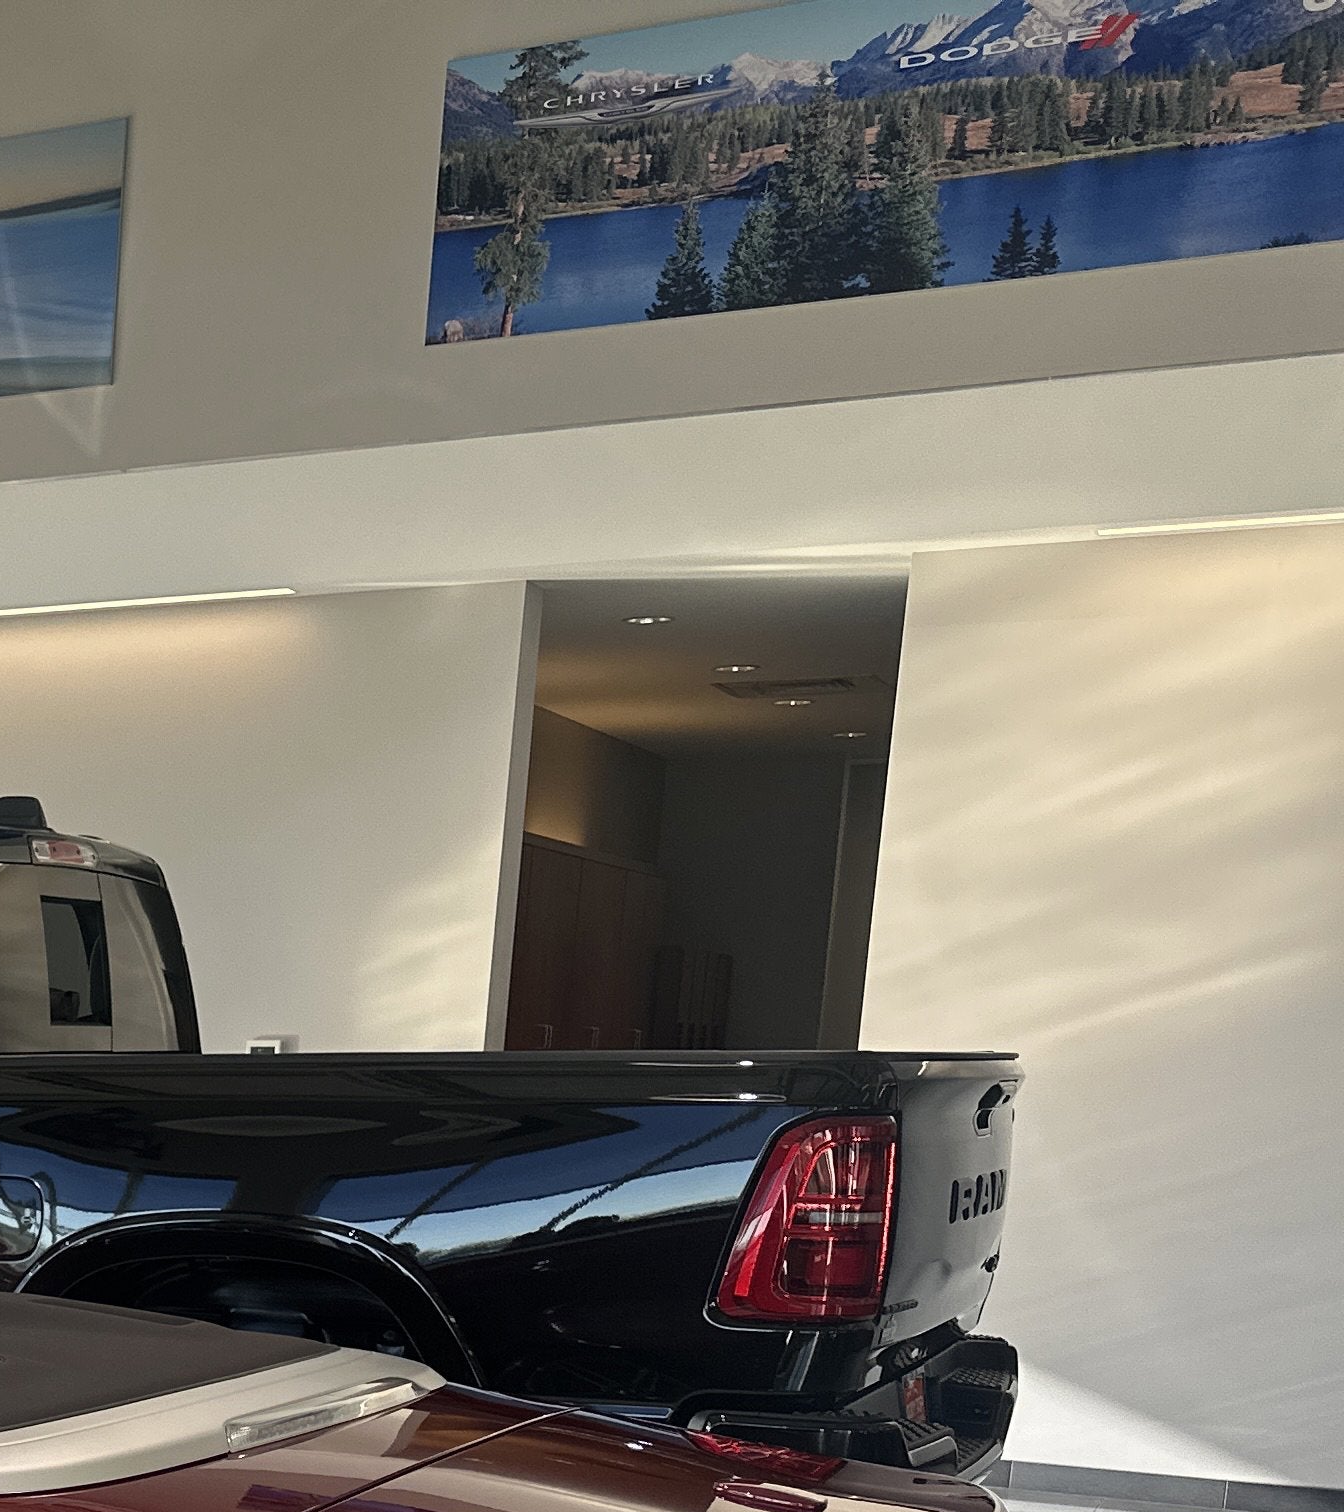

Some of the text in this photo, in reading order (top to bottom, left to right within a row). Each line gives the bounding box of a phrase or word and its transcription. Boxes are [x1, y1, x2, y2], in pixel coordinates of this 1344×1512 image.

[899, 26, 1102, 69] DODGE
[543, 73, 714, 109] CHRYSLER
[949, 1169, 1008, 1224] RAM
